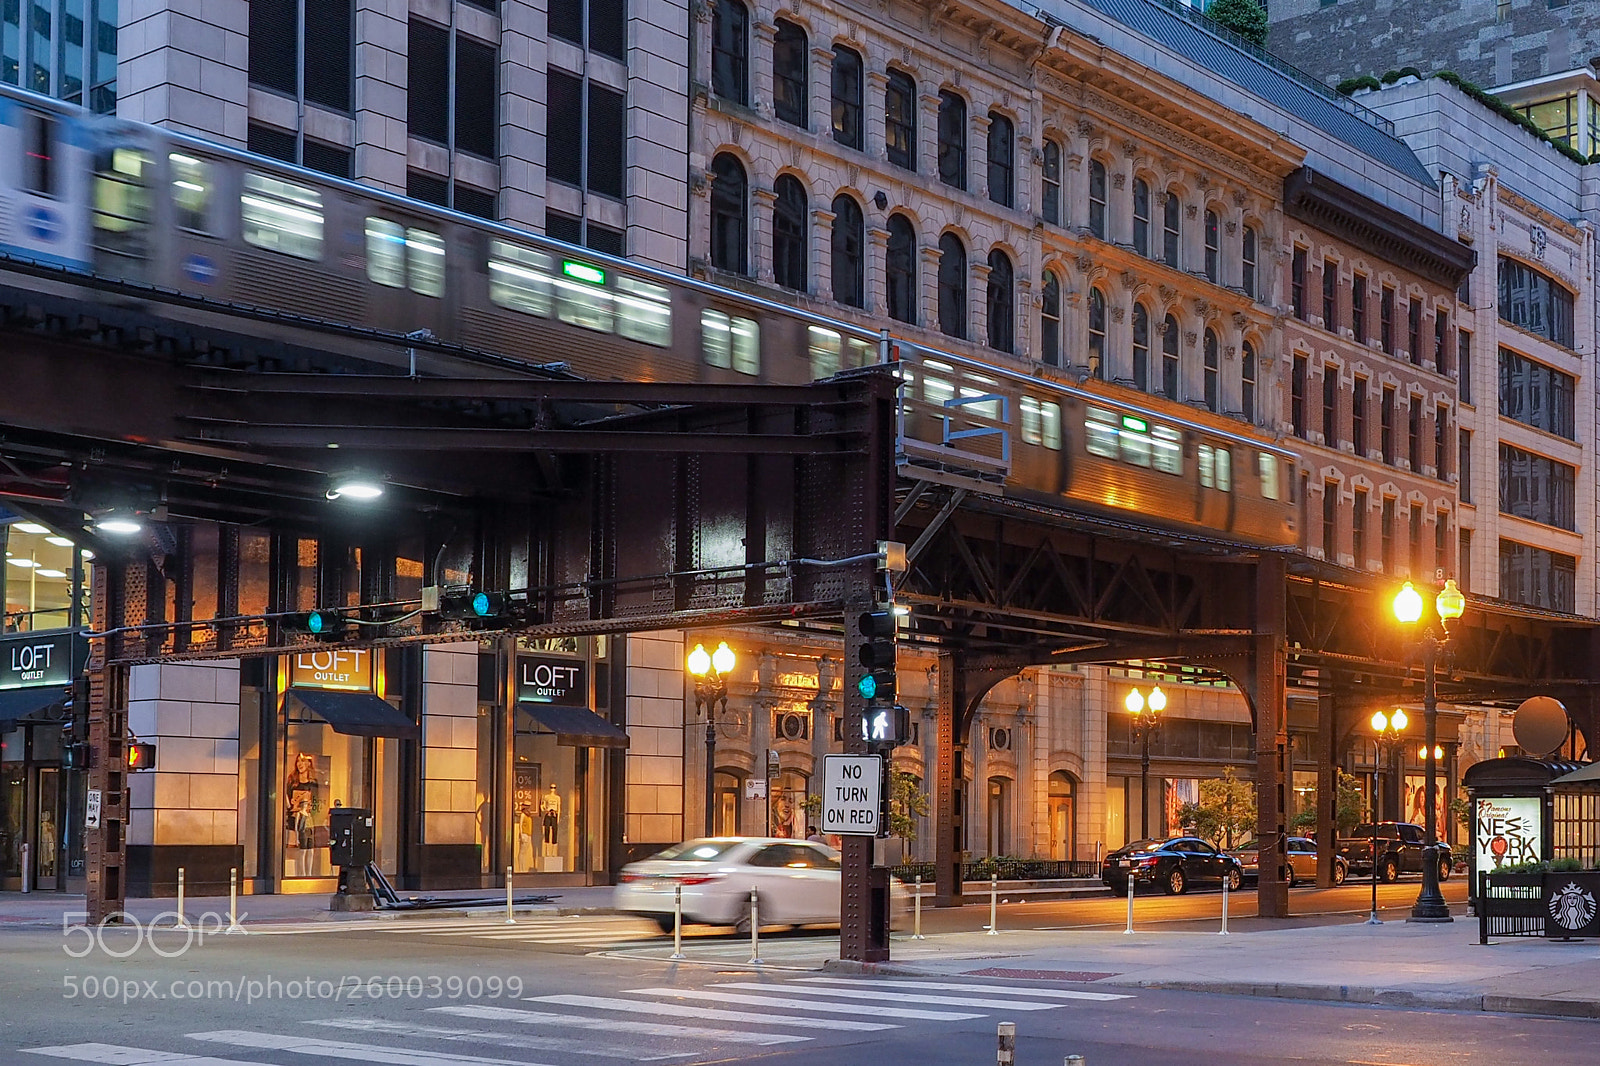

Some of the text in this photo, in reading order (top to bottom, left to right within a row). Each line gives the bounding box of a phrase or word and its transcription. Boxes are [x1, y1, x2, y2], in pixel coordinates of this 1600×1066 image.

[11, 644, 55, 671] LOFT
[298, 650, 366, 673] LOFT
[21, 670, 44, 680] OUTLET
[314, 671, 350, 682] OUTLET
[523, 663, 580, 688] LOFT
[536, 687, 566, 697] OUTLET
[842, 764, 862, 779] NO
[514, 775, 532, 785] 0%
[88, 793, 99, 803] ONE
[835, 787, 868, 802] TURN
[87, 803, 99, 813] WAY
[827, 808, 874, 824] ON RED
[1478, 816, 1521, 840] NEW
